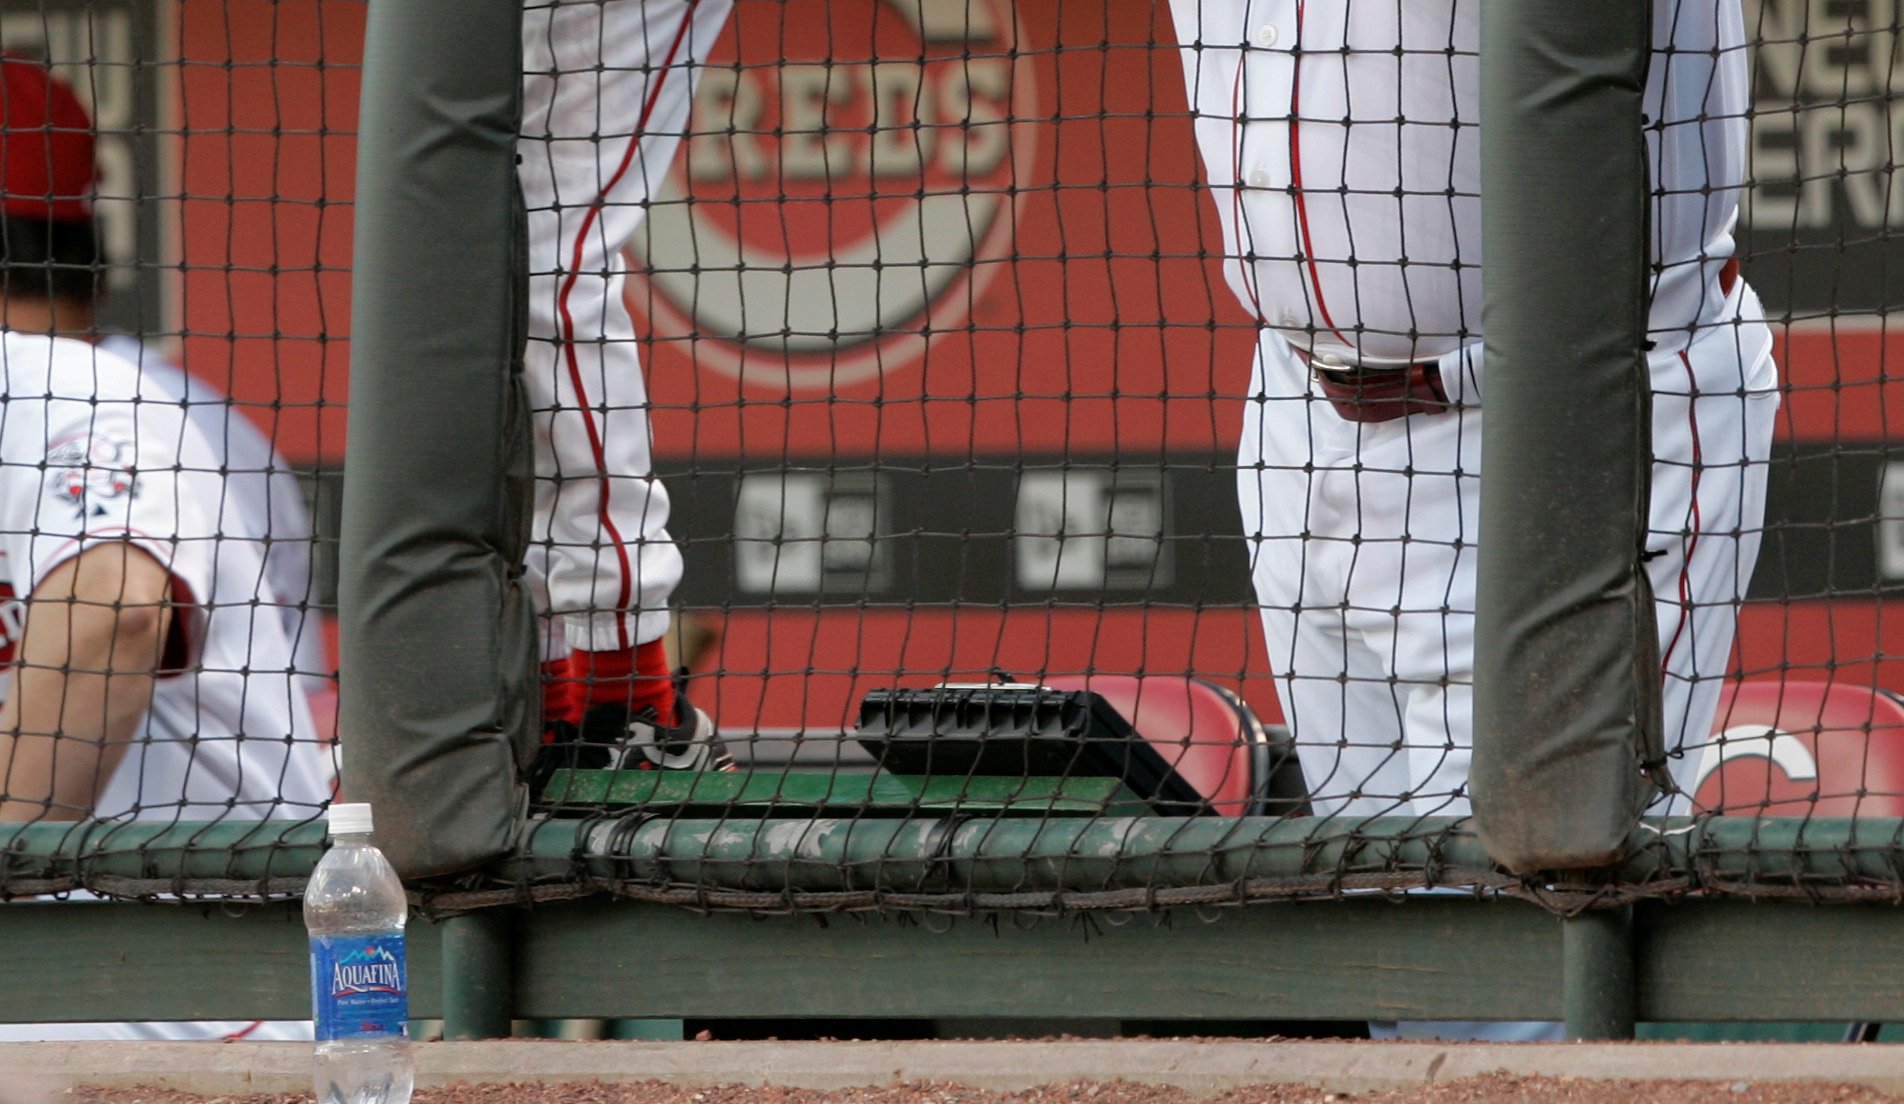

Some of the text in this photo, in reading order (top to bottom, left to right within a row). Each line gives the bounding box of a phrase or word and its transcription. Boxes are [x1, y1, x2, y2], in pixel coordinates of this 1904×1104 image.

[688, 60, 1012, 182] REDS
[1741, 101, 1904, 229] ER
[331, 961, 401, 995] AQUAFINA
